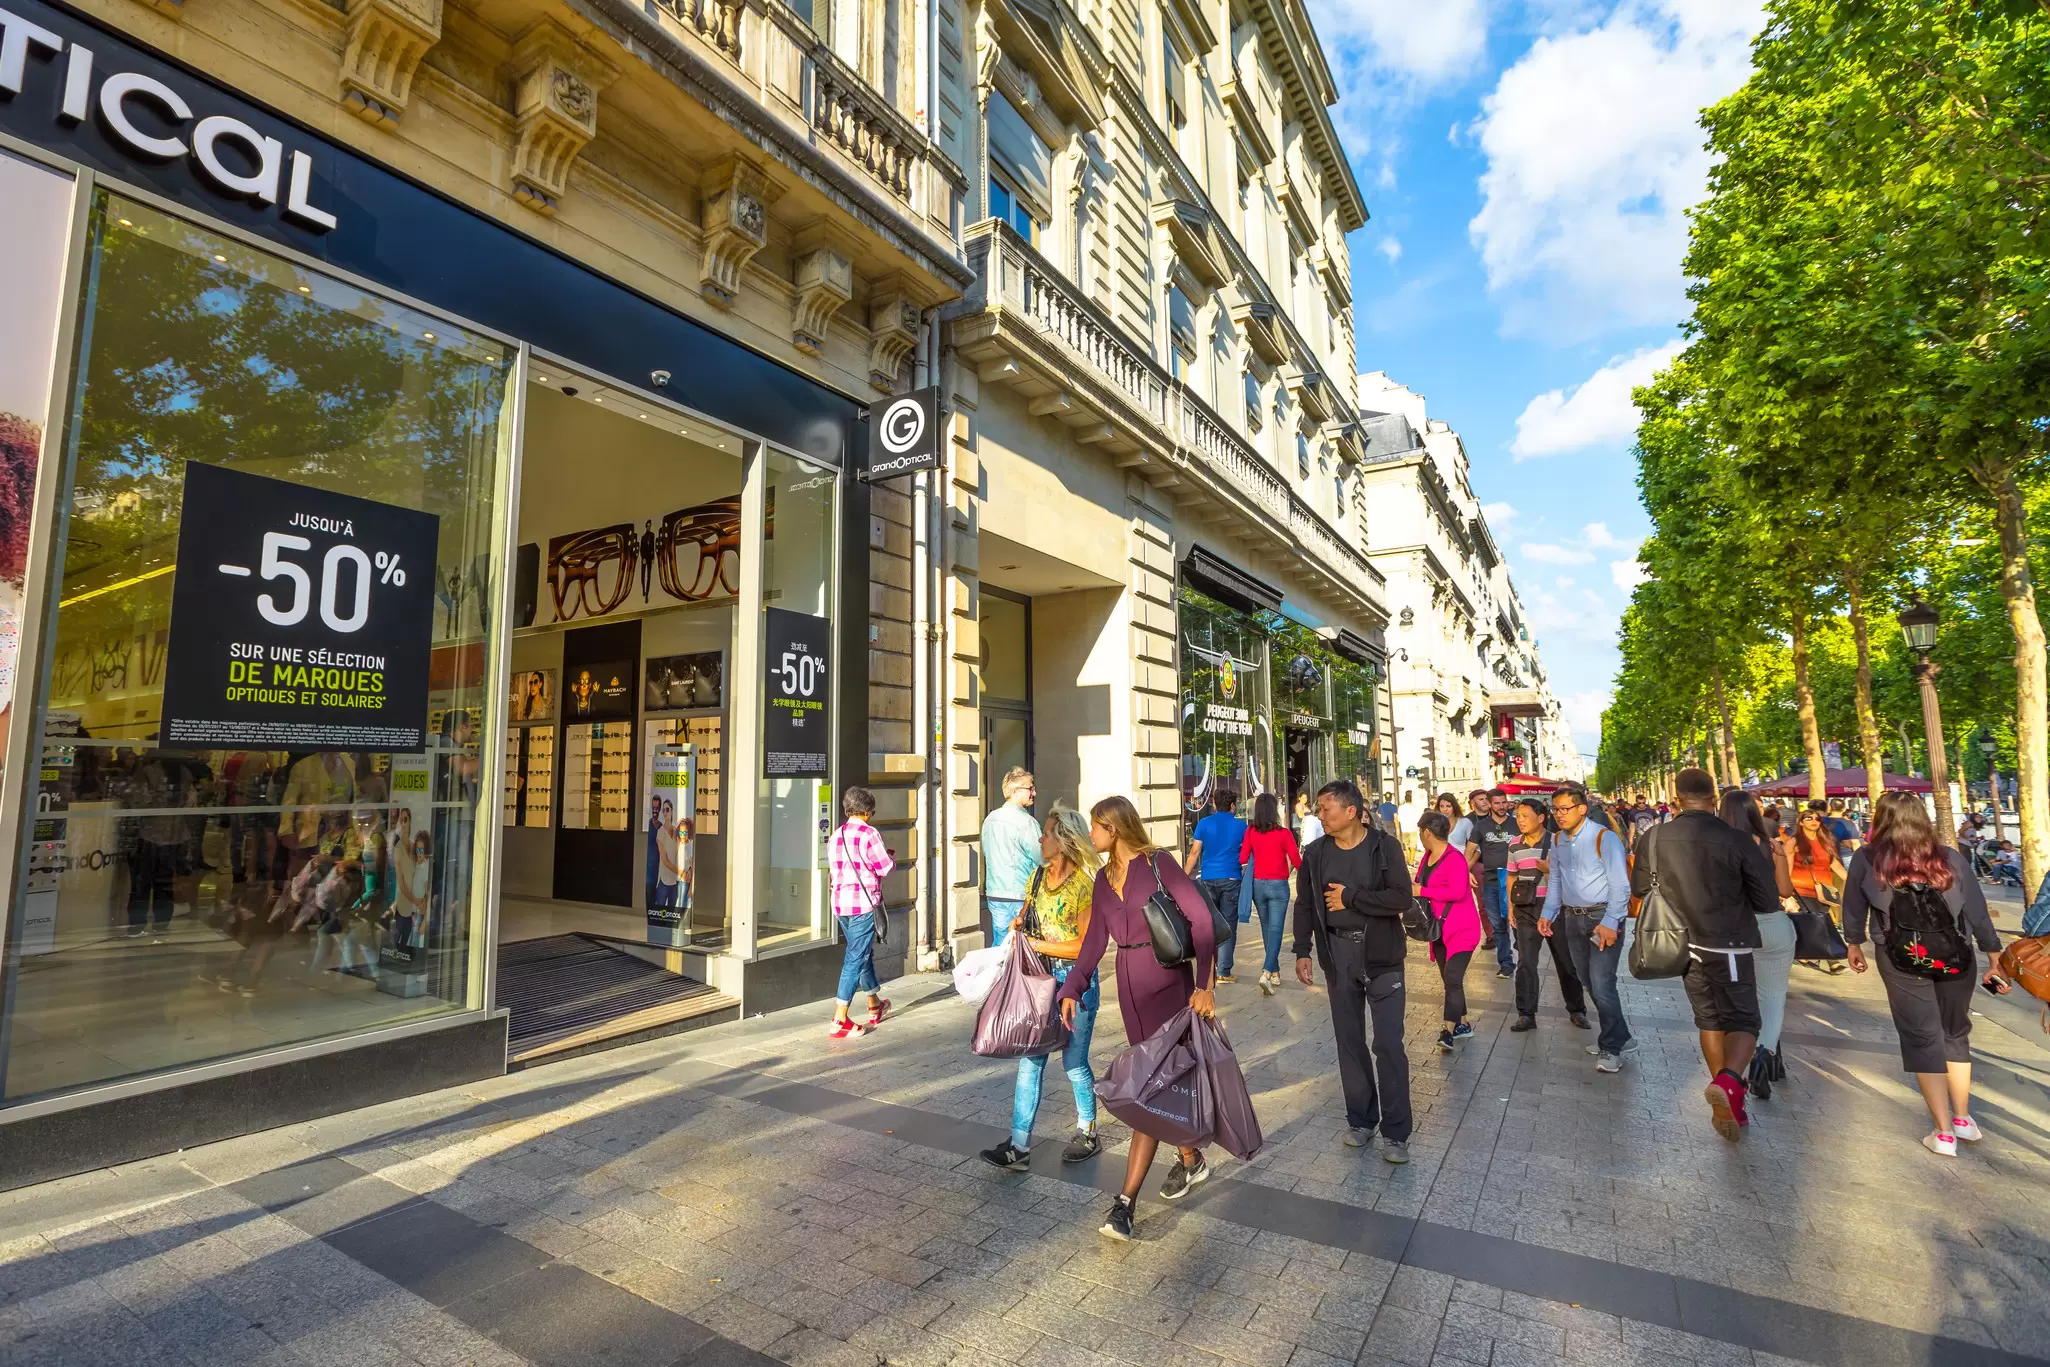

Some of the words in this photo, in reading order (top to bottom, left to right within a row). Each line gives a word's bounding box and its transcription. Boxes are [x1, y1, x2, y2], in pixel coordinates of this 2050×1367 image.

[289, 512, 354, 537] JUSQU'À
[218, 532, 406, 633] -50%
[230, 643, 264, 660] SUR
[270, 646, 302, 664] UNE
[308, 648, 385, 670] SÉLECTION
[229, 660, 263, 685] DE
[273, 664, 384, 693] MARQUES
[771, 652, 824, 696] -50%
[226, 686, 296, 704] OPTIQUES
[300, 690, 318, 706] ET
[1207, 704, 1235, 719] PEUGEOT
[1294, 714, 1319, 728] PEUGEOT
[1203, 718, 1217, 733] CAR
[1217, 720, 1226, 734] OF
[1226, 720, 1239, 734] THE
[1238, 722, 1252, 736] YEAR
[1172, 1084, 1197, 1098] OME
